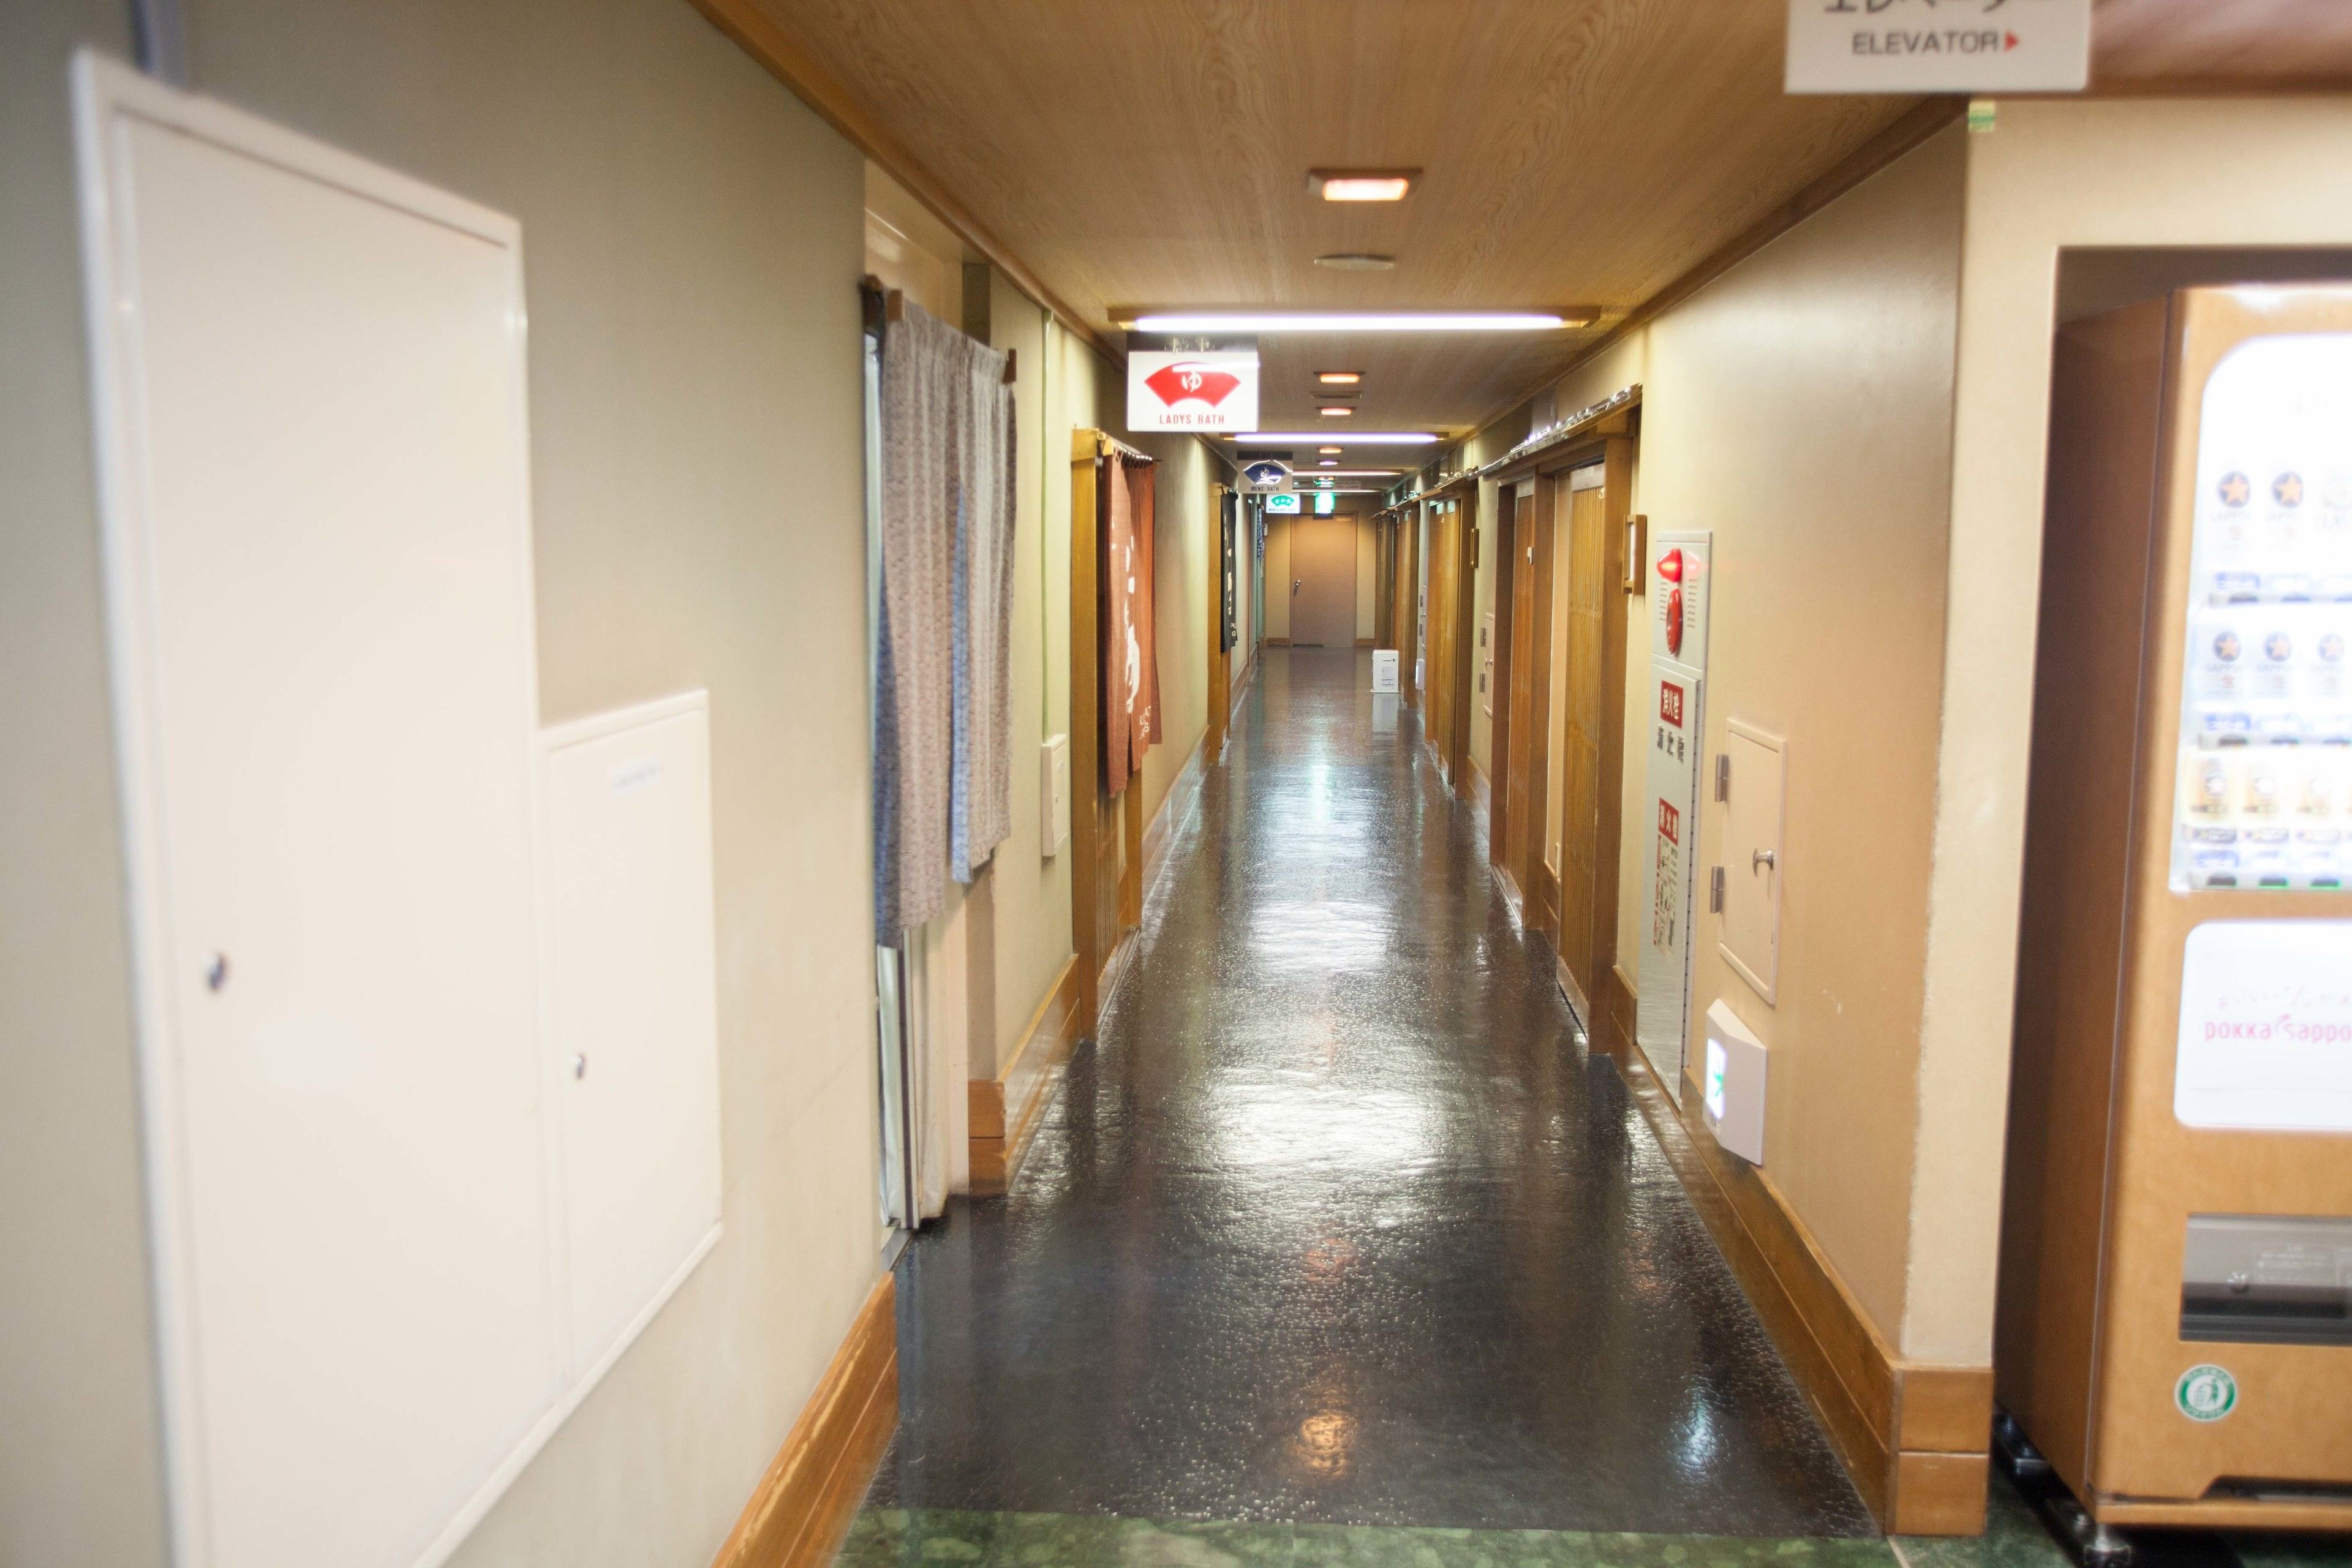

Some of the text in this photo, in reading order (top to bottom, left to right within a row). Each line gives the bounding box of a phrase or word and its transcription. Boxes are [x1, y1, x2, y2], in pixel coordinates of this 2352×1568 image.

[1851, 31, 1999, 56] ELEVATOR
[1182, 369, 1202, 393] ゆ
[1159, 414, 1225, 424] LADYS BATH
